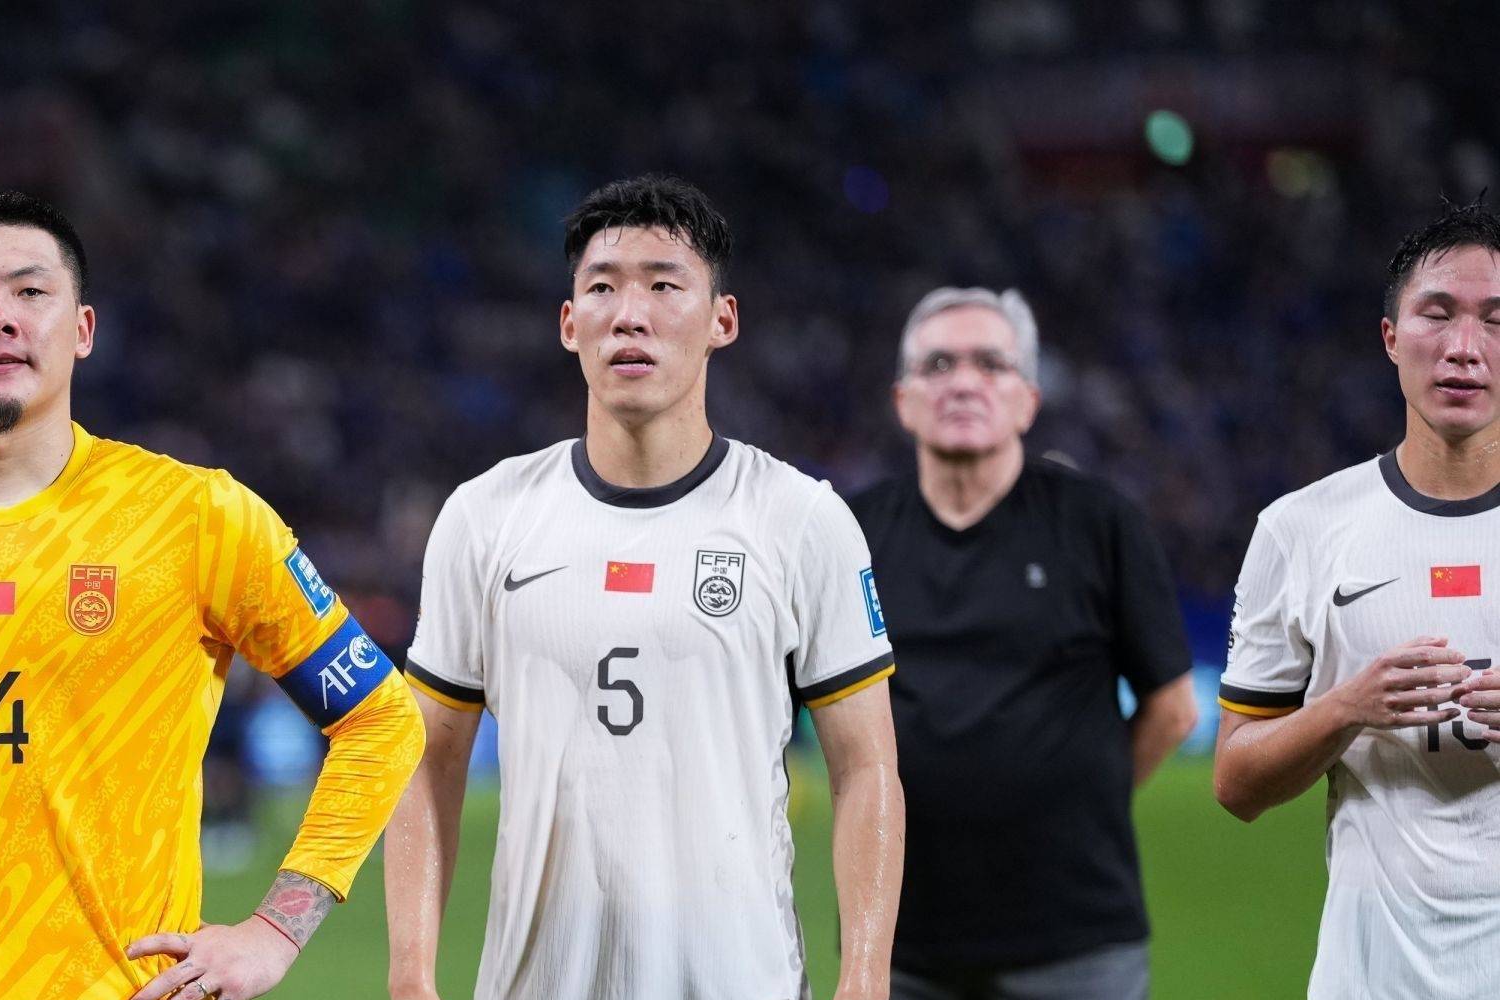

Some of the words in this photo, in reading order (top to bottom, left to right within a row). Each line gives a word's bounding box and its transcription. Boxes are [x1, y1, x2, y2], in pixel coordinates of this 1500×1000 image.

[72, 567, 114, 581] CFA
[701, 554, 740, 567] CFA
[318, 633, 378, 711] AFC
[597, 646, 644, 736] 5
